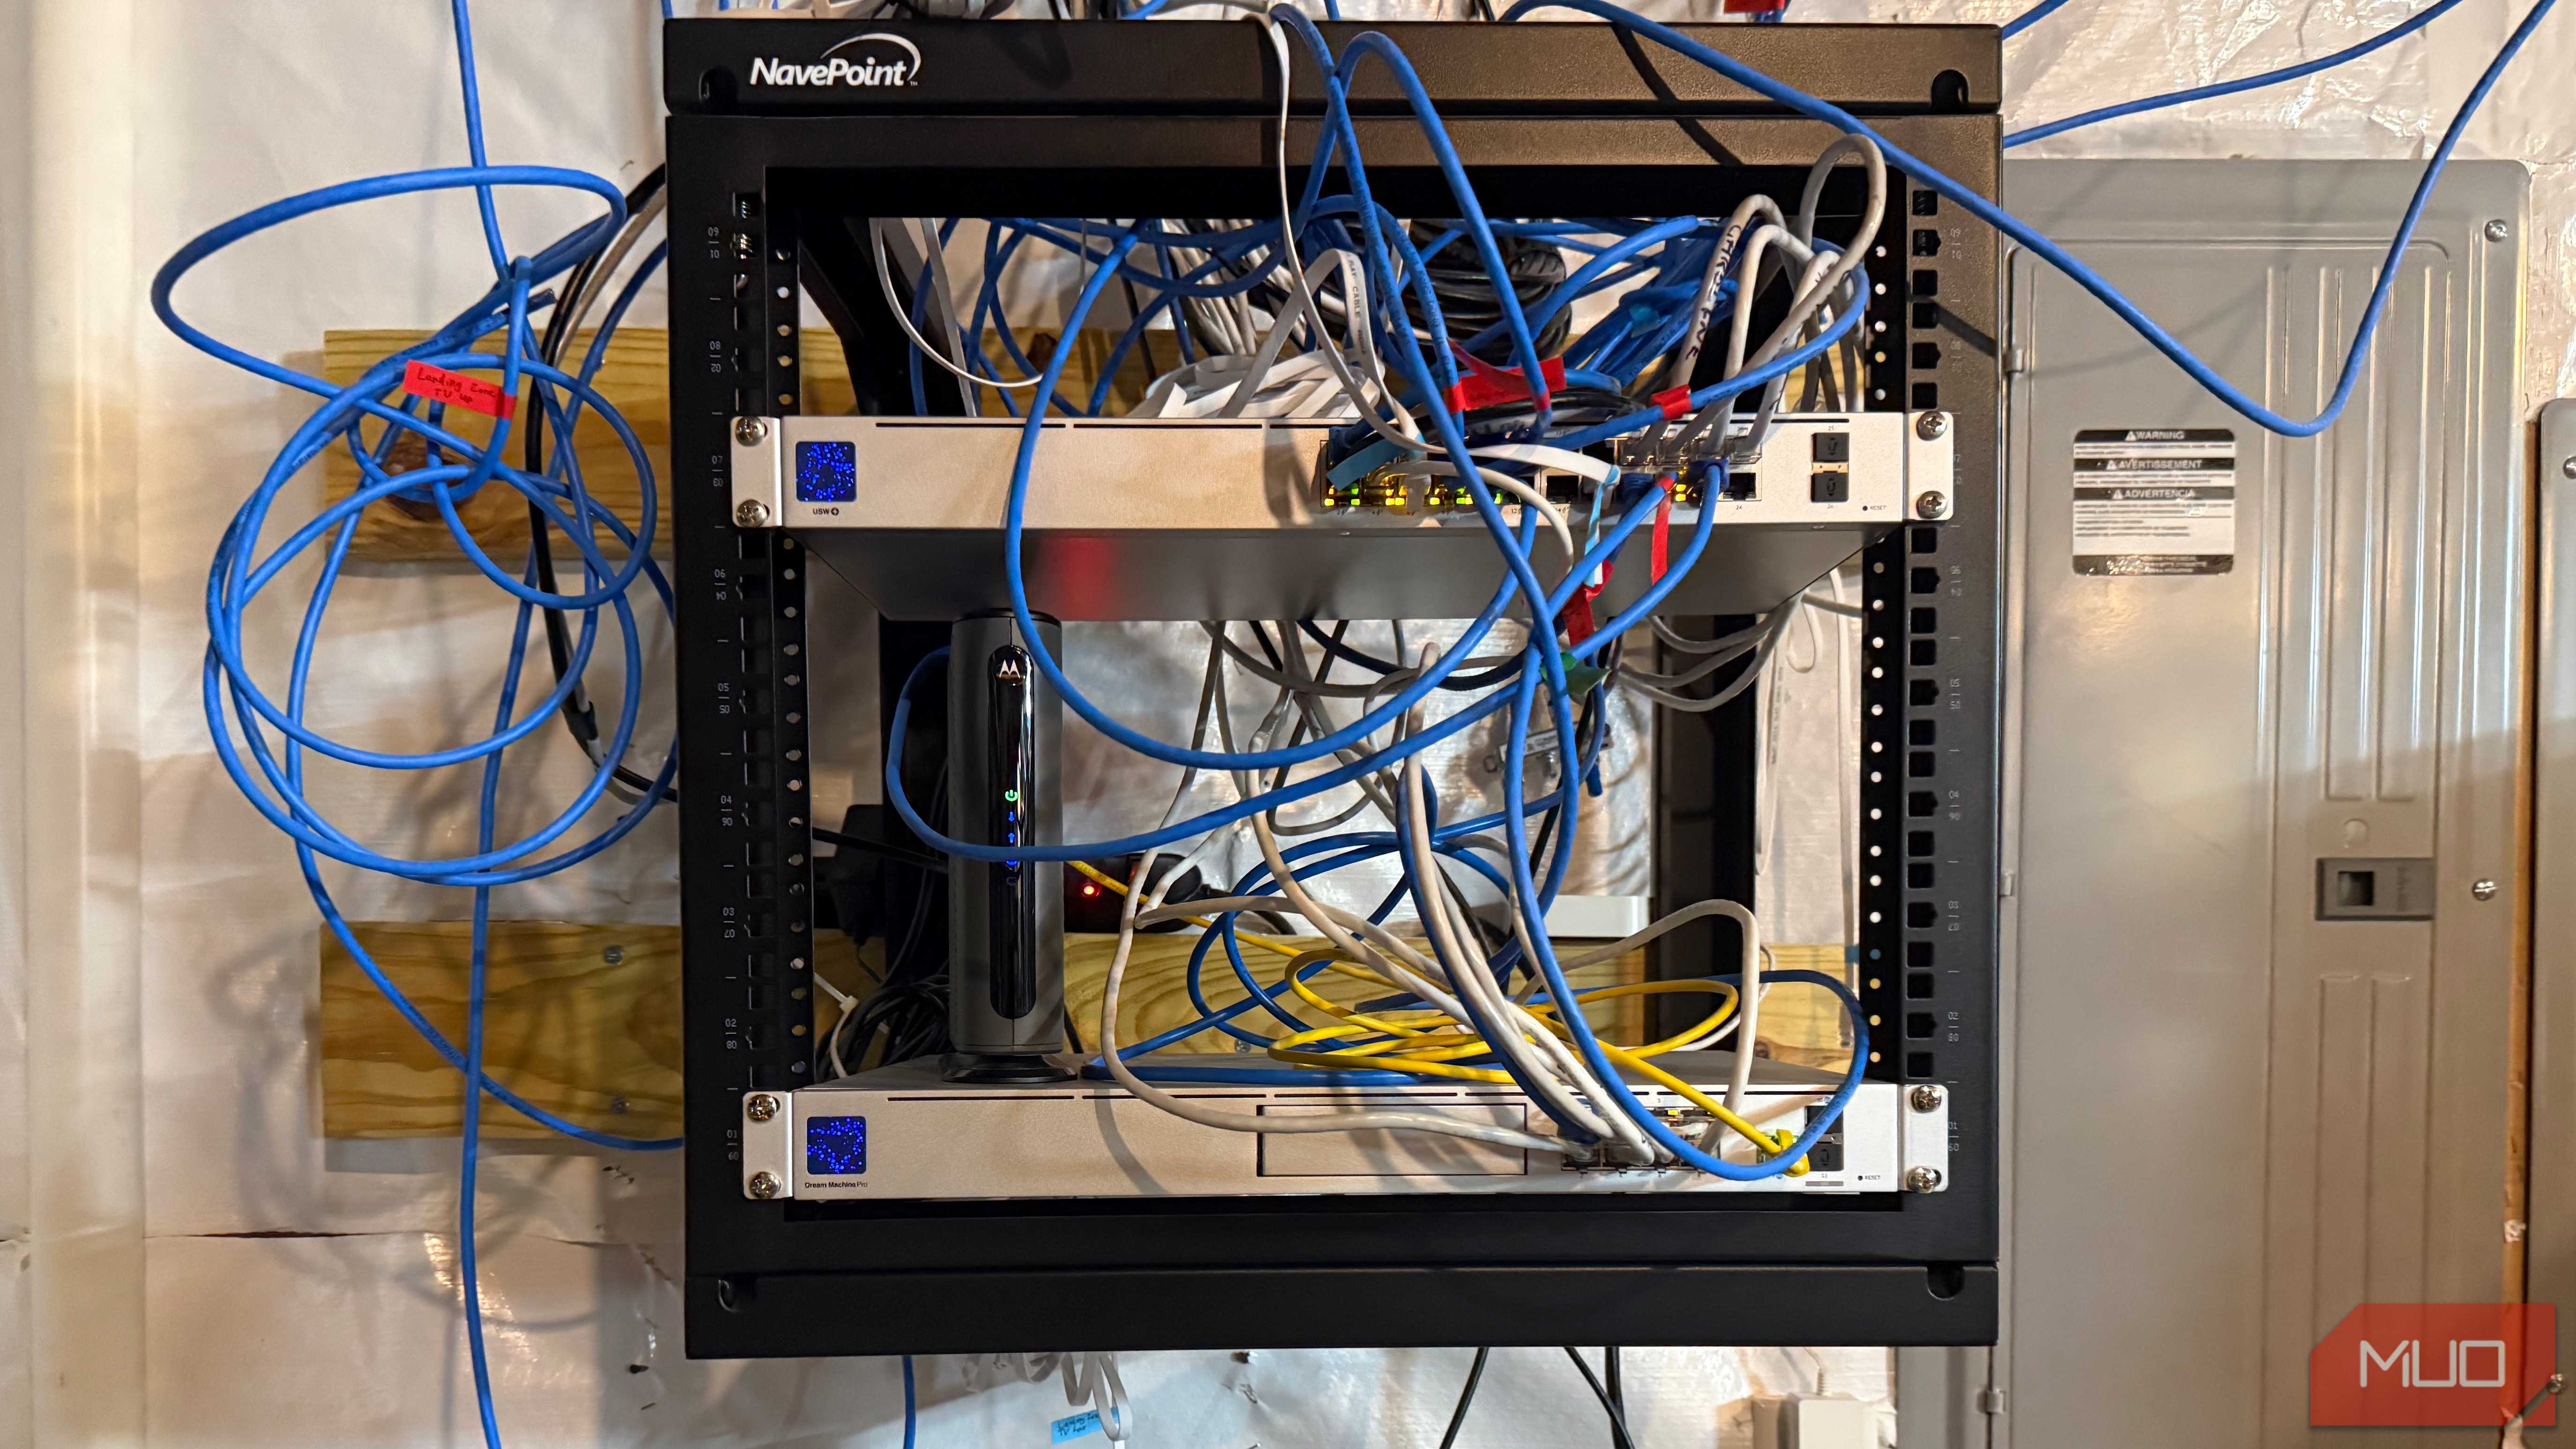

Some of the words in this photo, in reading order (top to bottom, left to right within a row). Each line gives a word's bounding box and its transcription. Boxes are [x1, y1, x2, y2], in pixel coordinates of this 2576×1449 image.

[750, 56, 907, 87] NavePoint
[708, 227, 719, 237] 09
[1352, 286, 1361, 318] CABLE
[710, 341, 721, 350] 08
[417, 367, 462, 392] Landing
[2136, 431, 2185, 440] WARNING
[712, 455, 722, 464] 07
[2118, 460, 2203, 469] AVERTISSEMENT
[2124, 489, 2196, 498] ADVERTENCIA
[715, 569, 725, 578] 06
[718, 683, 729, 691] 05
[721, 795, 732, 804] 04
[723, 907, 734, 916] 03
[725, 1018, 737, 1027] 02
[727, 1129, 737, 1138] 01
